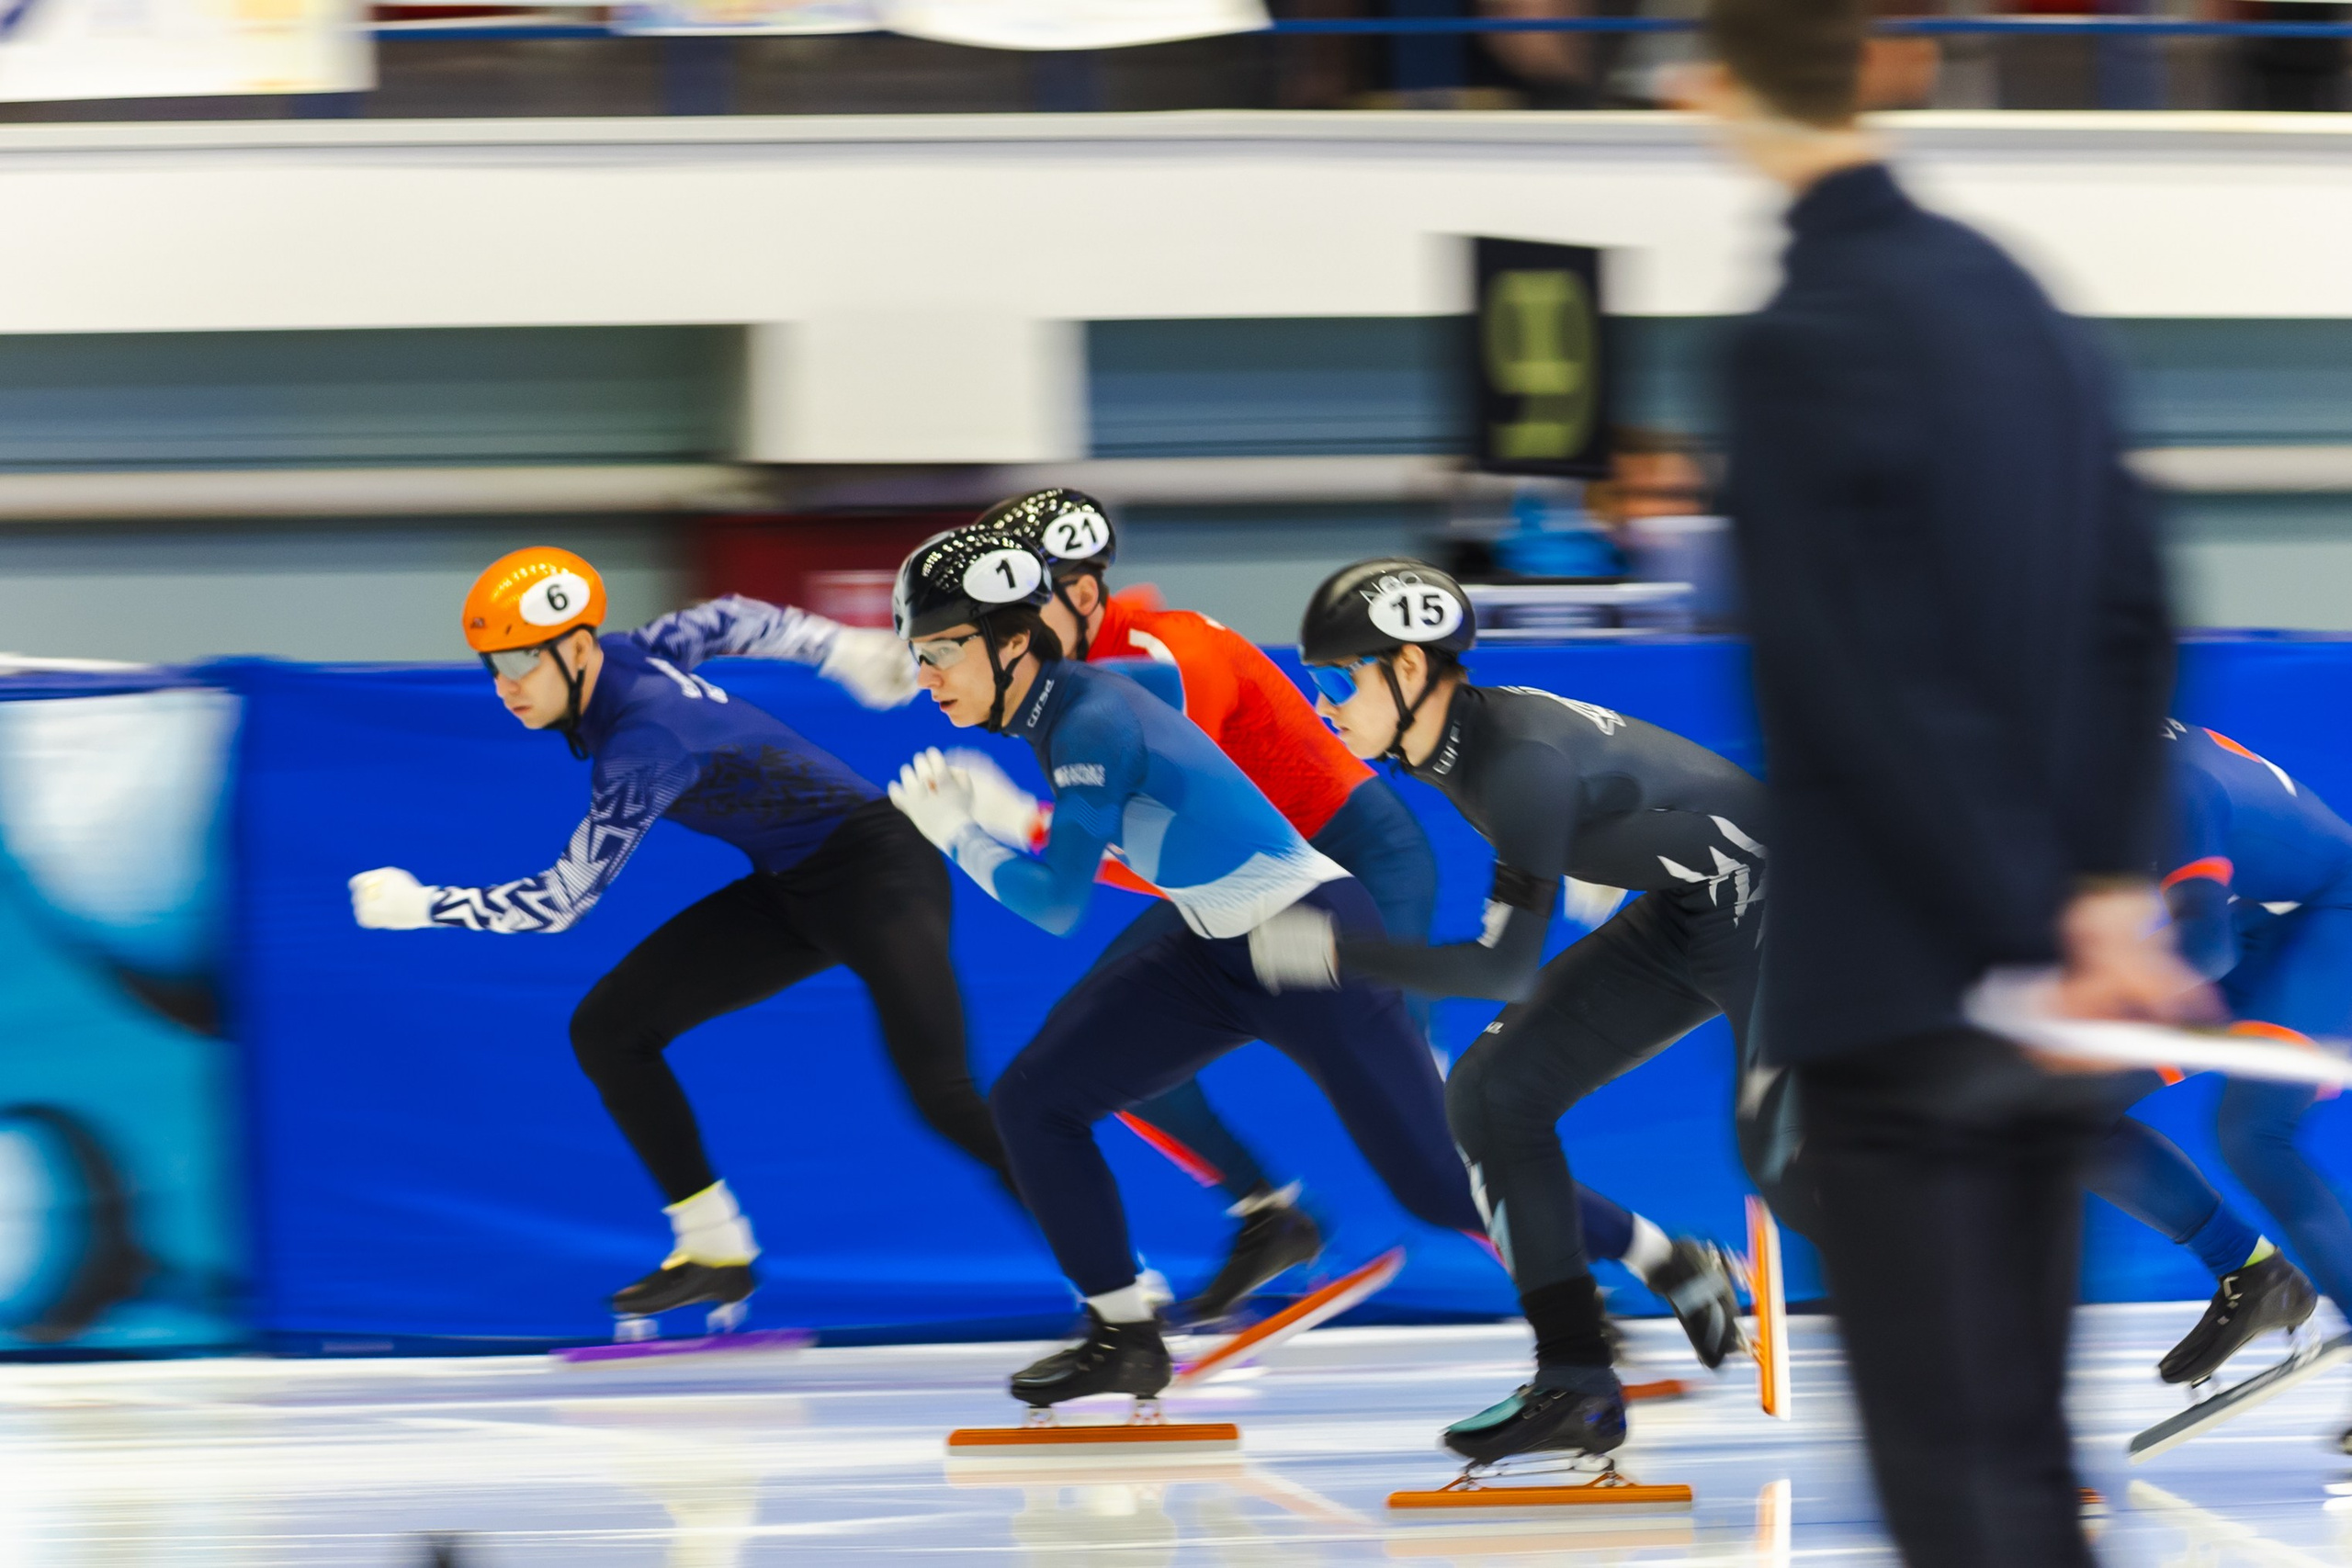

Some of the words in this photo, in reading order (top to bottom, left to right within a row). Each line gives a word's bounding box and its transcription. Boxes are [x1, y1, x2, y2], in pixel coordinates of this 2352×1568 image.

[1057, 517, 1098, 552] 21
[995, 557, 1016, 589] 1
[547, 583, 568, 611] 6
[1390, 594, 1444, 626] 15
